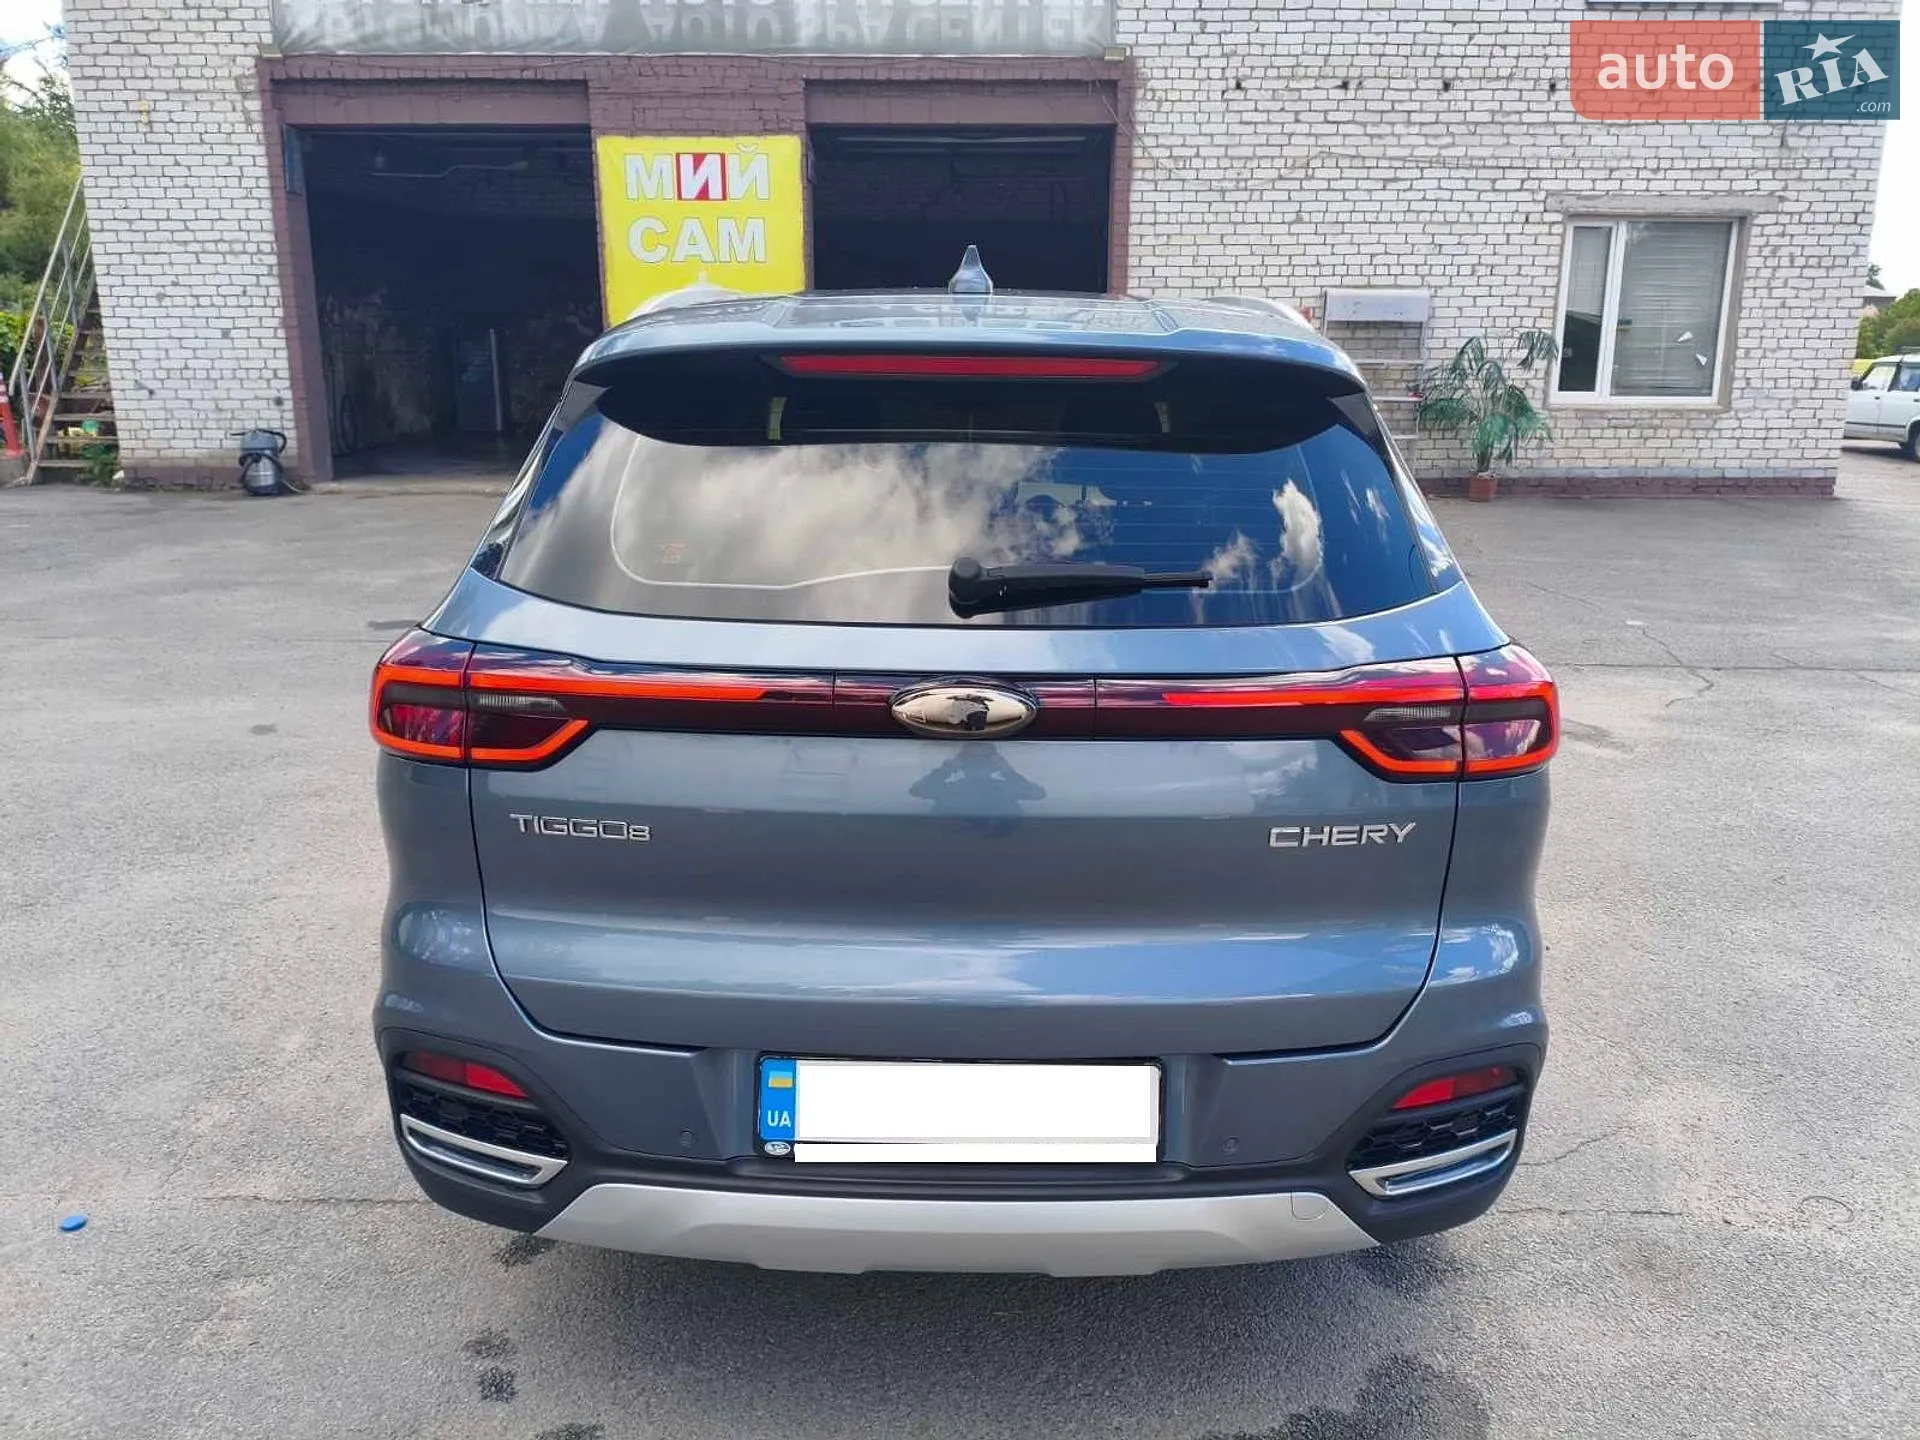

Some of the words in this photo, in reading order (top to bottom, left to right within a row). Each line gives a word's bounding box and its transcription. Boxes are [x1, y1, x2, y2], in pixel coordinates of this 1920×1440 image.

[625, 143, 769, 201] МИЙ
[627, 216, 767, 263] САМ
[1269, 822, 1416, 848] CHERY
[767, 1109, 792, 1128] UA
